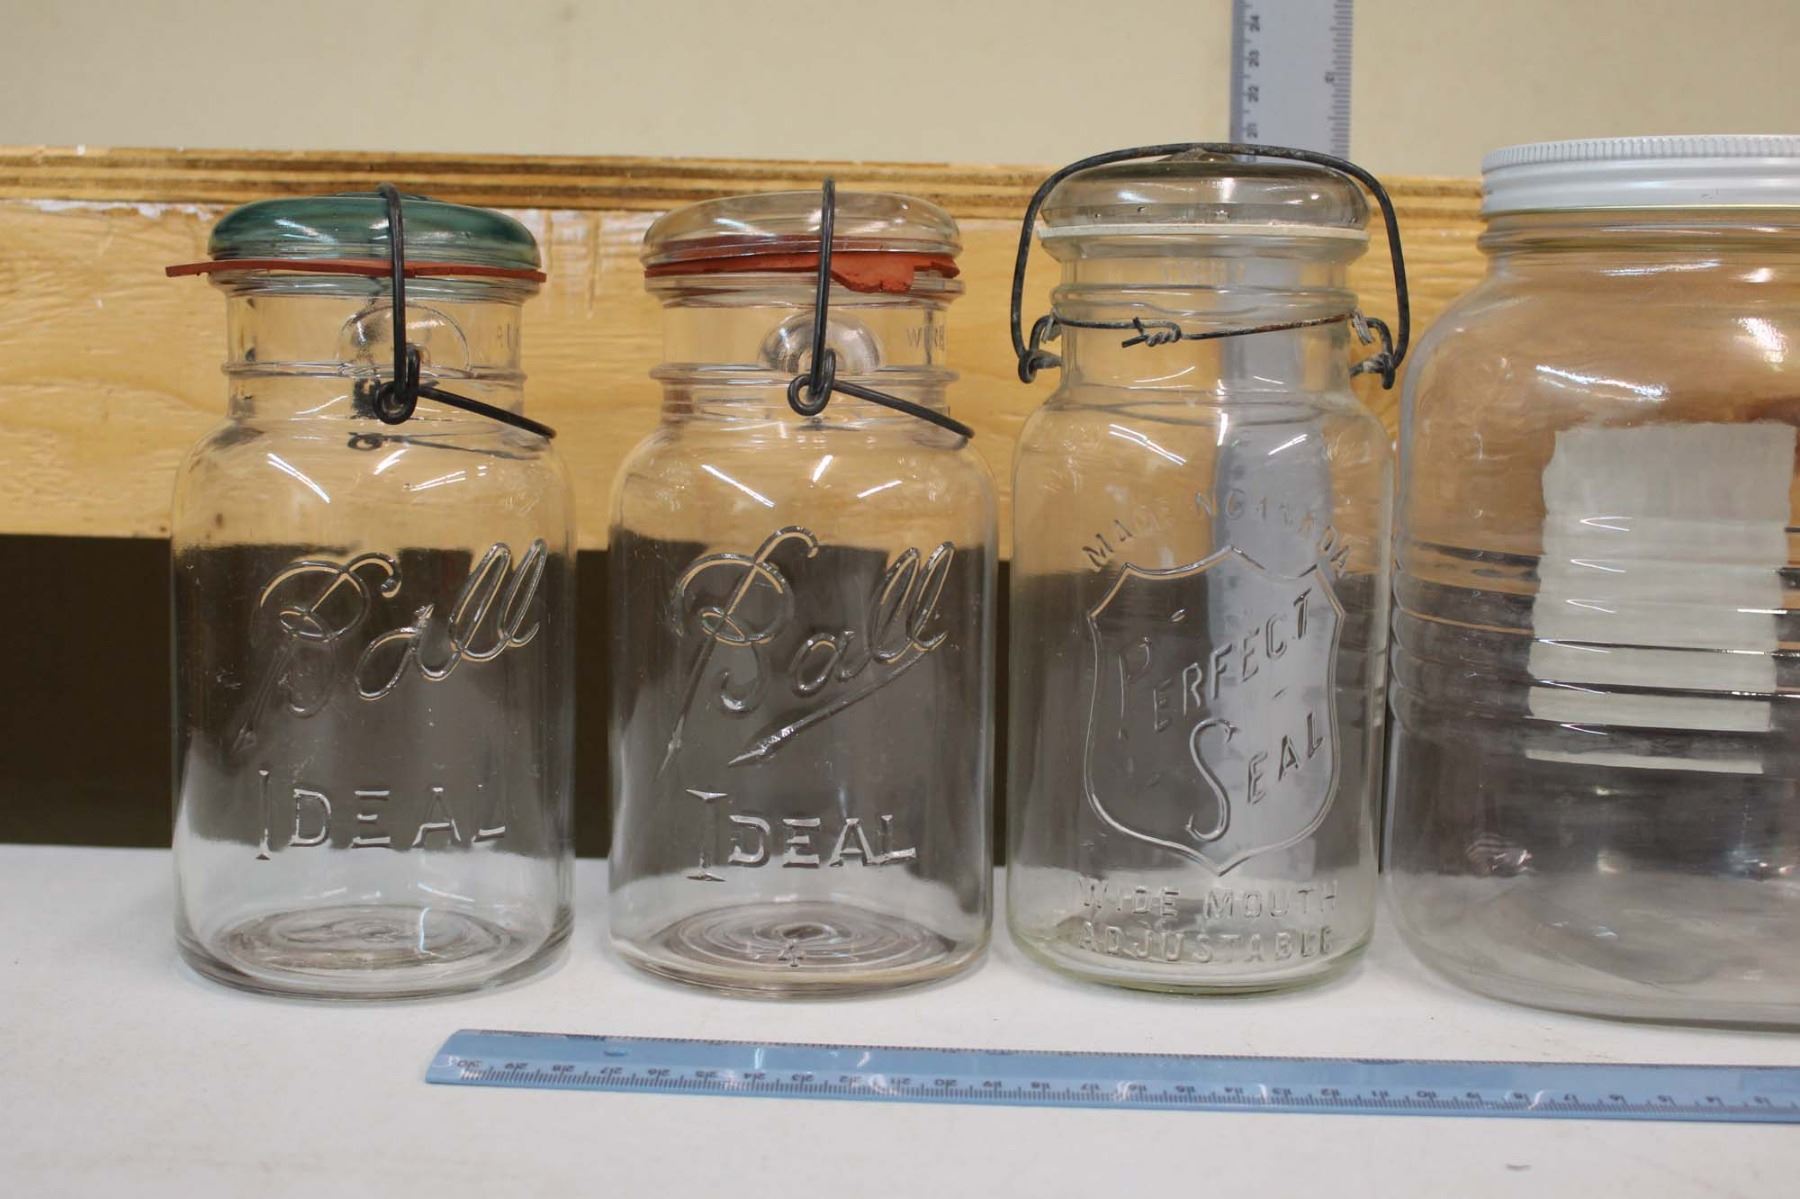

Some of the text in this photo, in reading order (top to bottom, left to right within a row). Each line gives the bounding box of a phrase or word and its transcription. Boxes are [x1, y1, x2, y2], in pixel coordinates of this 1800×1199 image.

[1248, 49, 1259, 68] 23
[1249, 14, 1260, 32] 24
[1248, 85, 1259, 103] 22
[238, 538, 548, 752] Ball
[654, 525, 956, 781] Ball
[1117, 588, 1313, 740] PERFECT
[1185, 711, 1326, 842] SEAL
[685, 787, 917, 882] IDEAL
[1202, 879, 1339, 920] MOUTH
